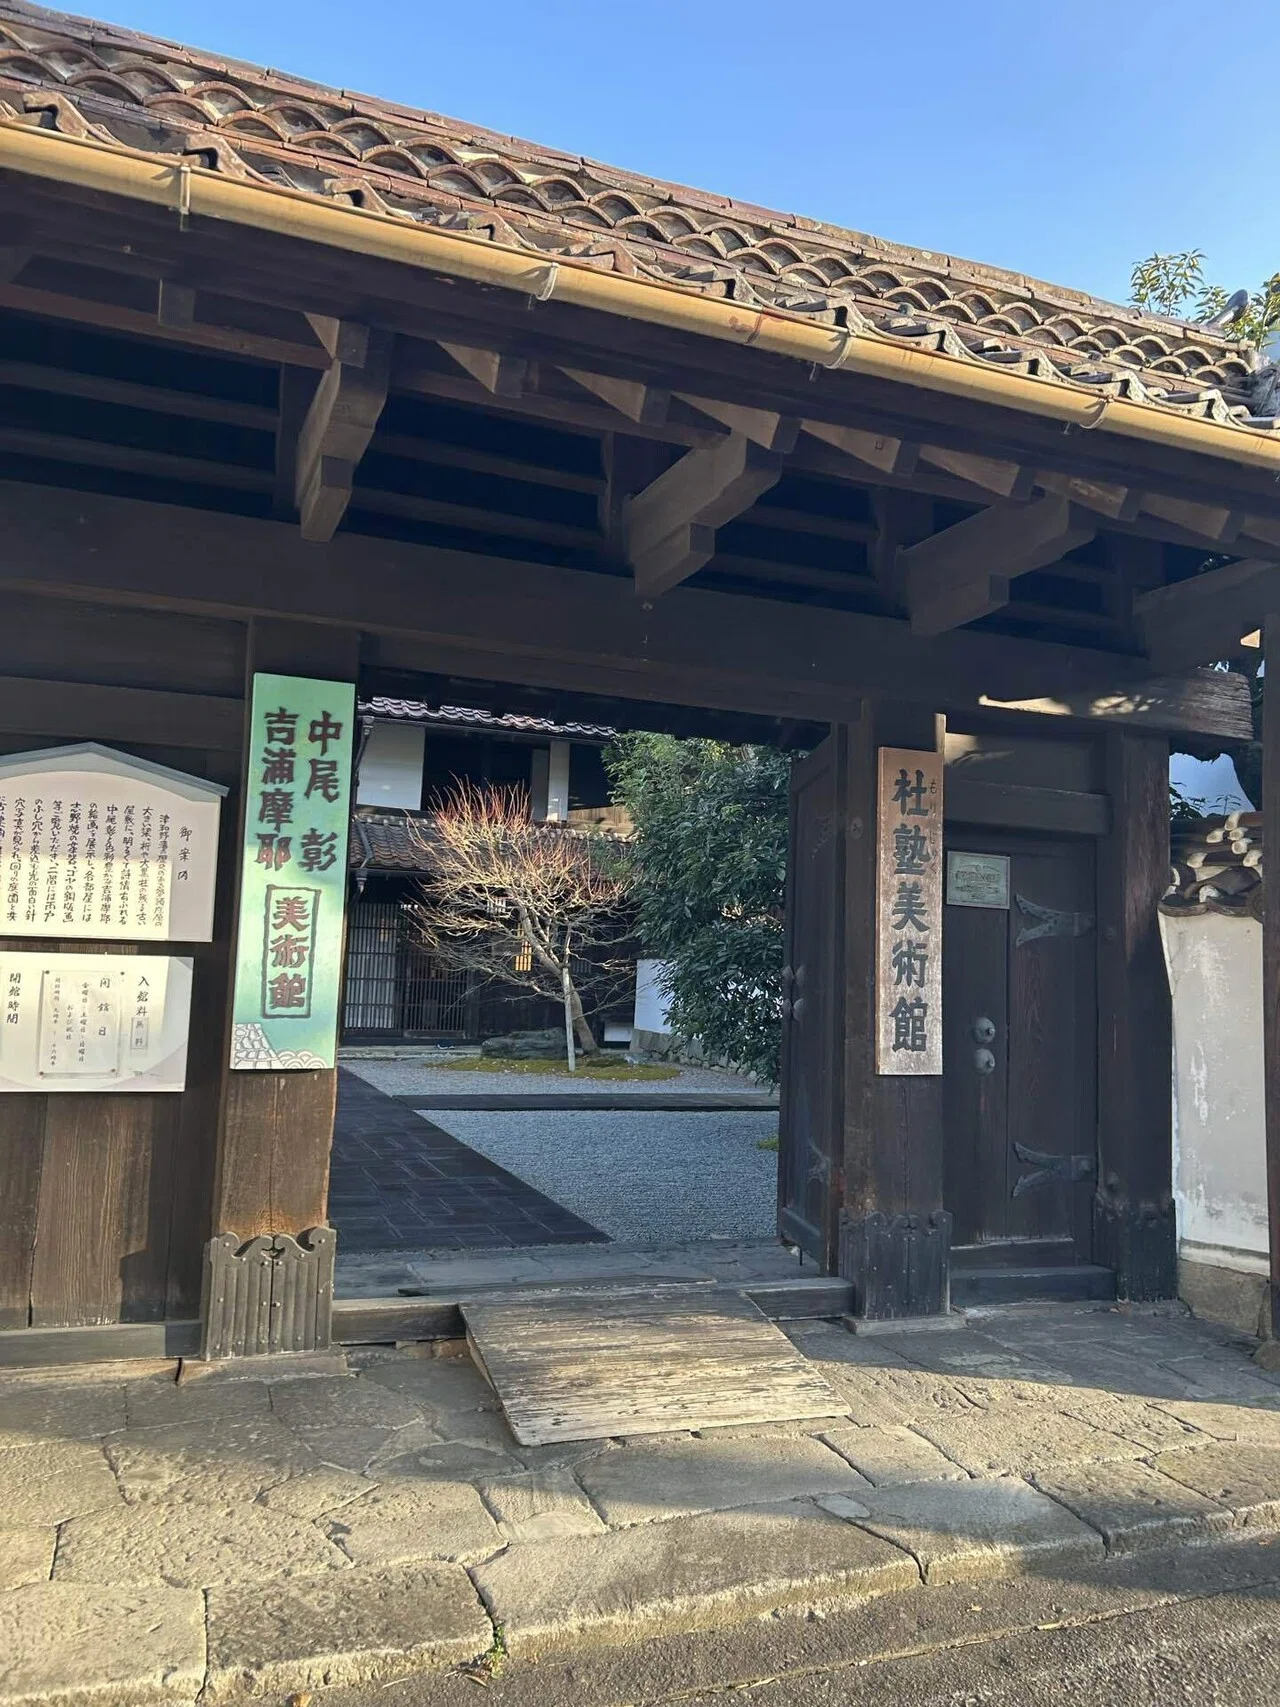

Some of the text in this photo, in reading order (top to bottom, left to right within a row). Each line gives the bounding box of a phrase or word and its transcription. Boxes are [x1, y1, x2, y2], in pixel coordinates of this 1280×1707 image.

[254, 706, 300, 871] 吉浦摩耶
[298, 711, 343, 873] 中尾 彰
[177, 826, 193, 881] 御案内
[888, 768, 931, 1052] 杜塾美術館
[6, 972, 22, 1025] 開館時間
[135, 975, 150, 1017] 入館料
[267, 895, 311, 1010] 美術館
